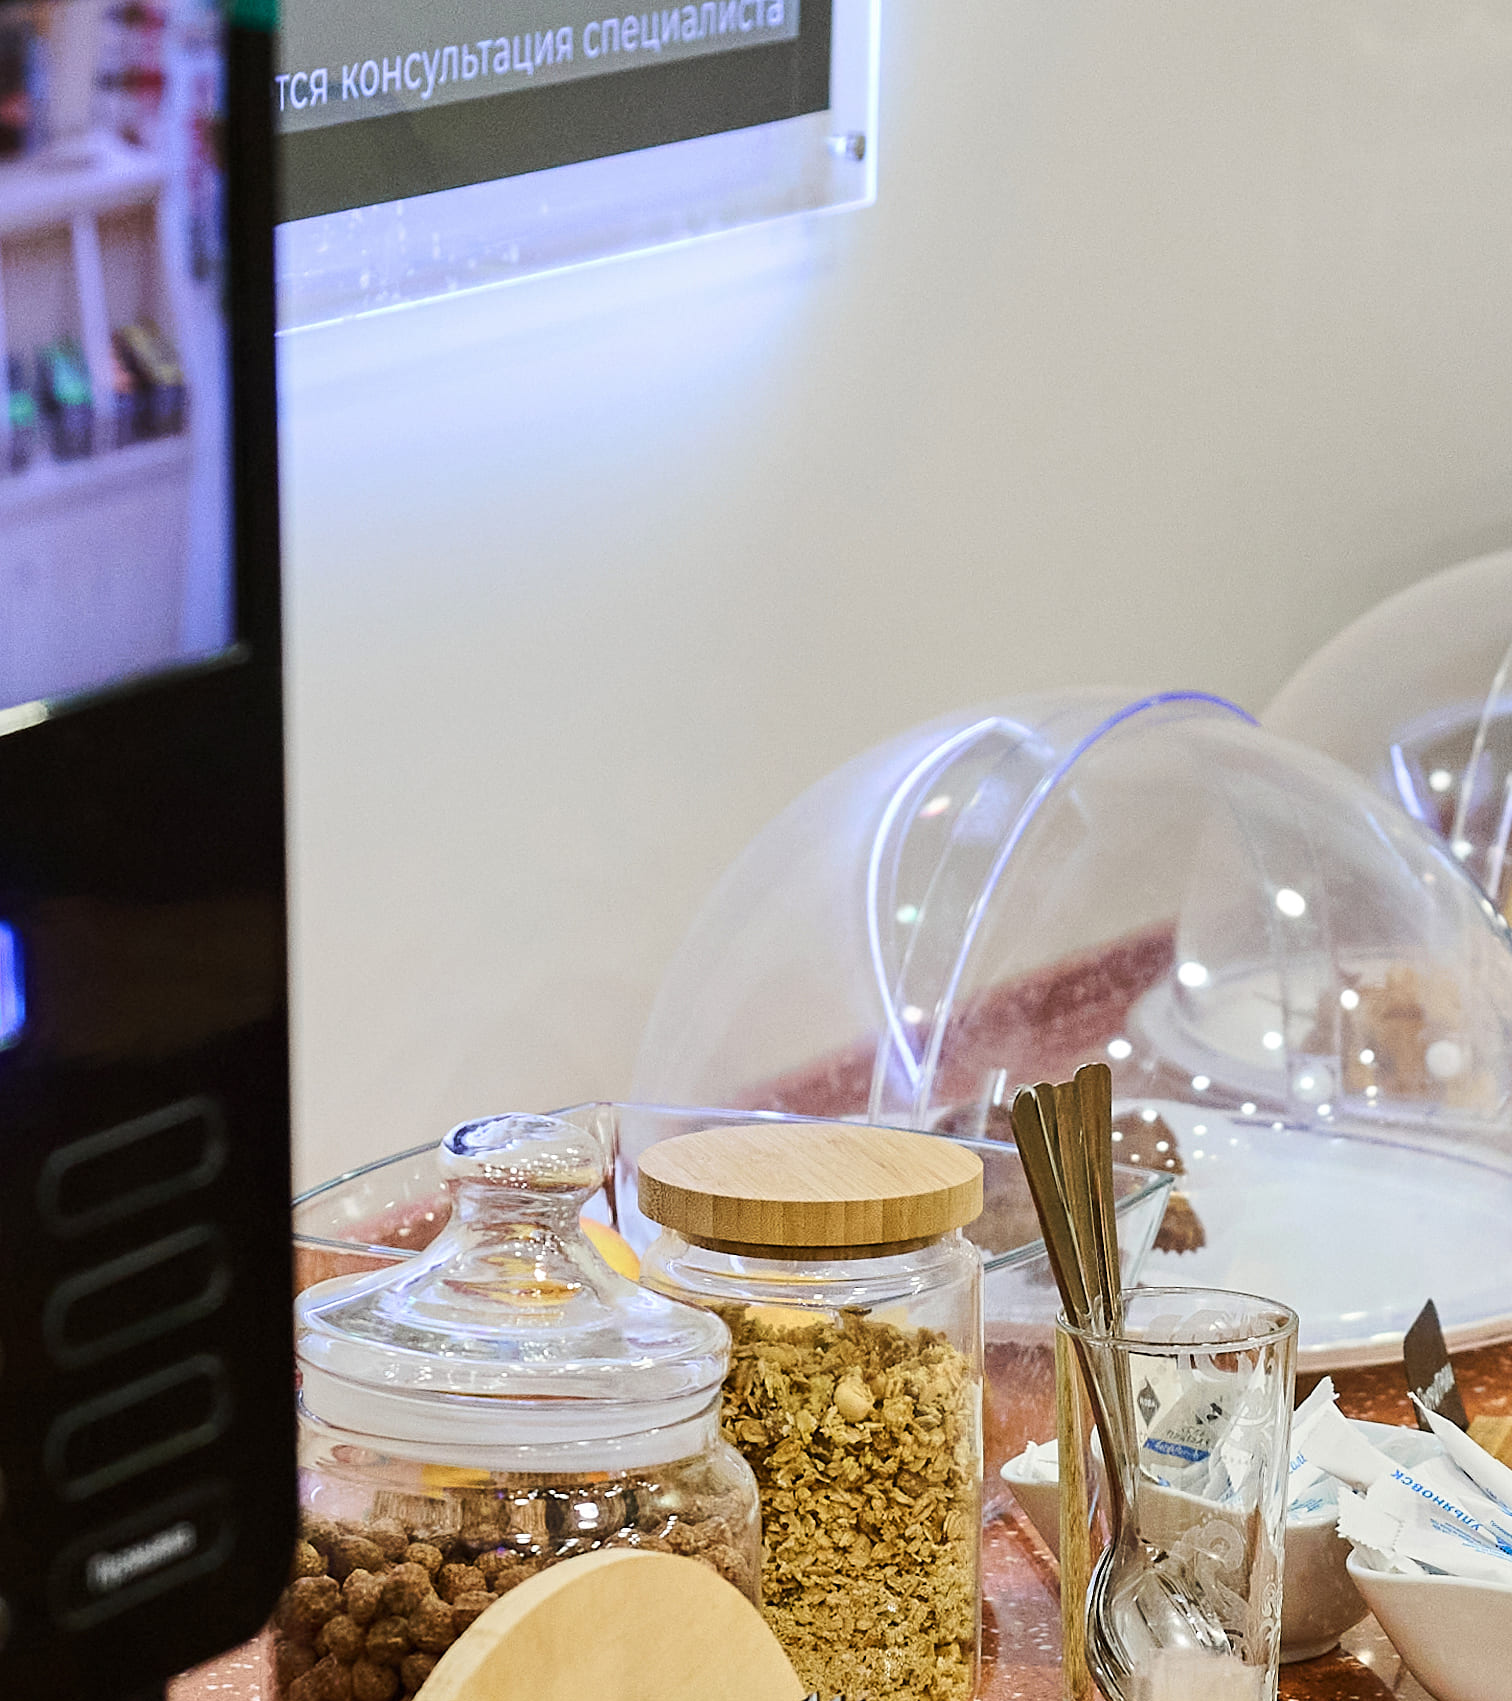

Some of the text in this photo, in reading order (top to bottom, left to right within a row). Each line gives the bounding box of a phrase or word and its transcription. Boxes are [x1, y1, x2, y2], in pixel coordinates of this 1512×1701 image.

[341, 25, 574, 101] консультация
[582, 0, 786, 60] специалиста
[1390, 1467, 1483, 1533] УЛЬЯНОВСК
